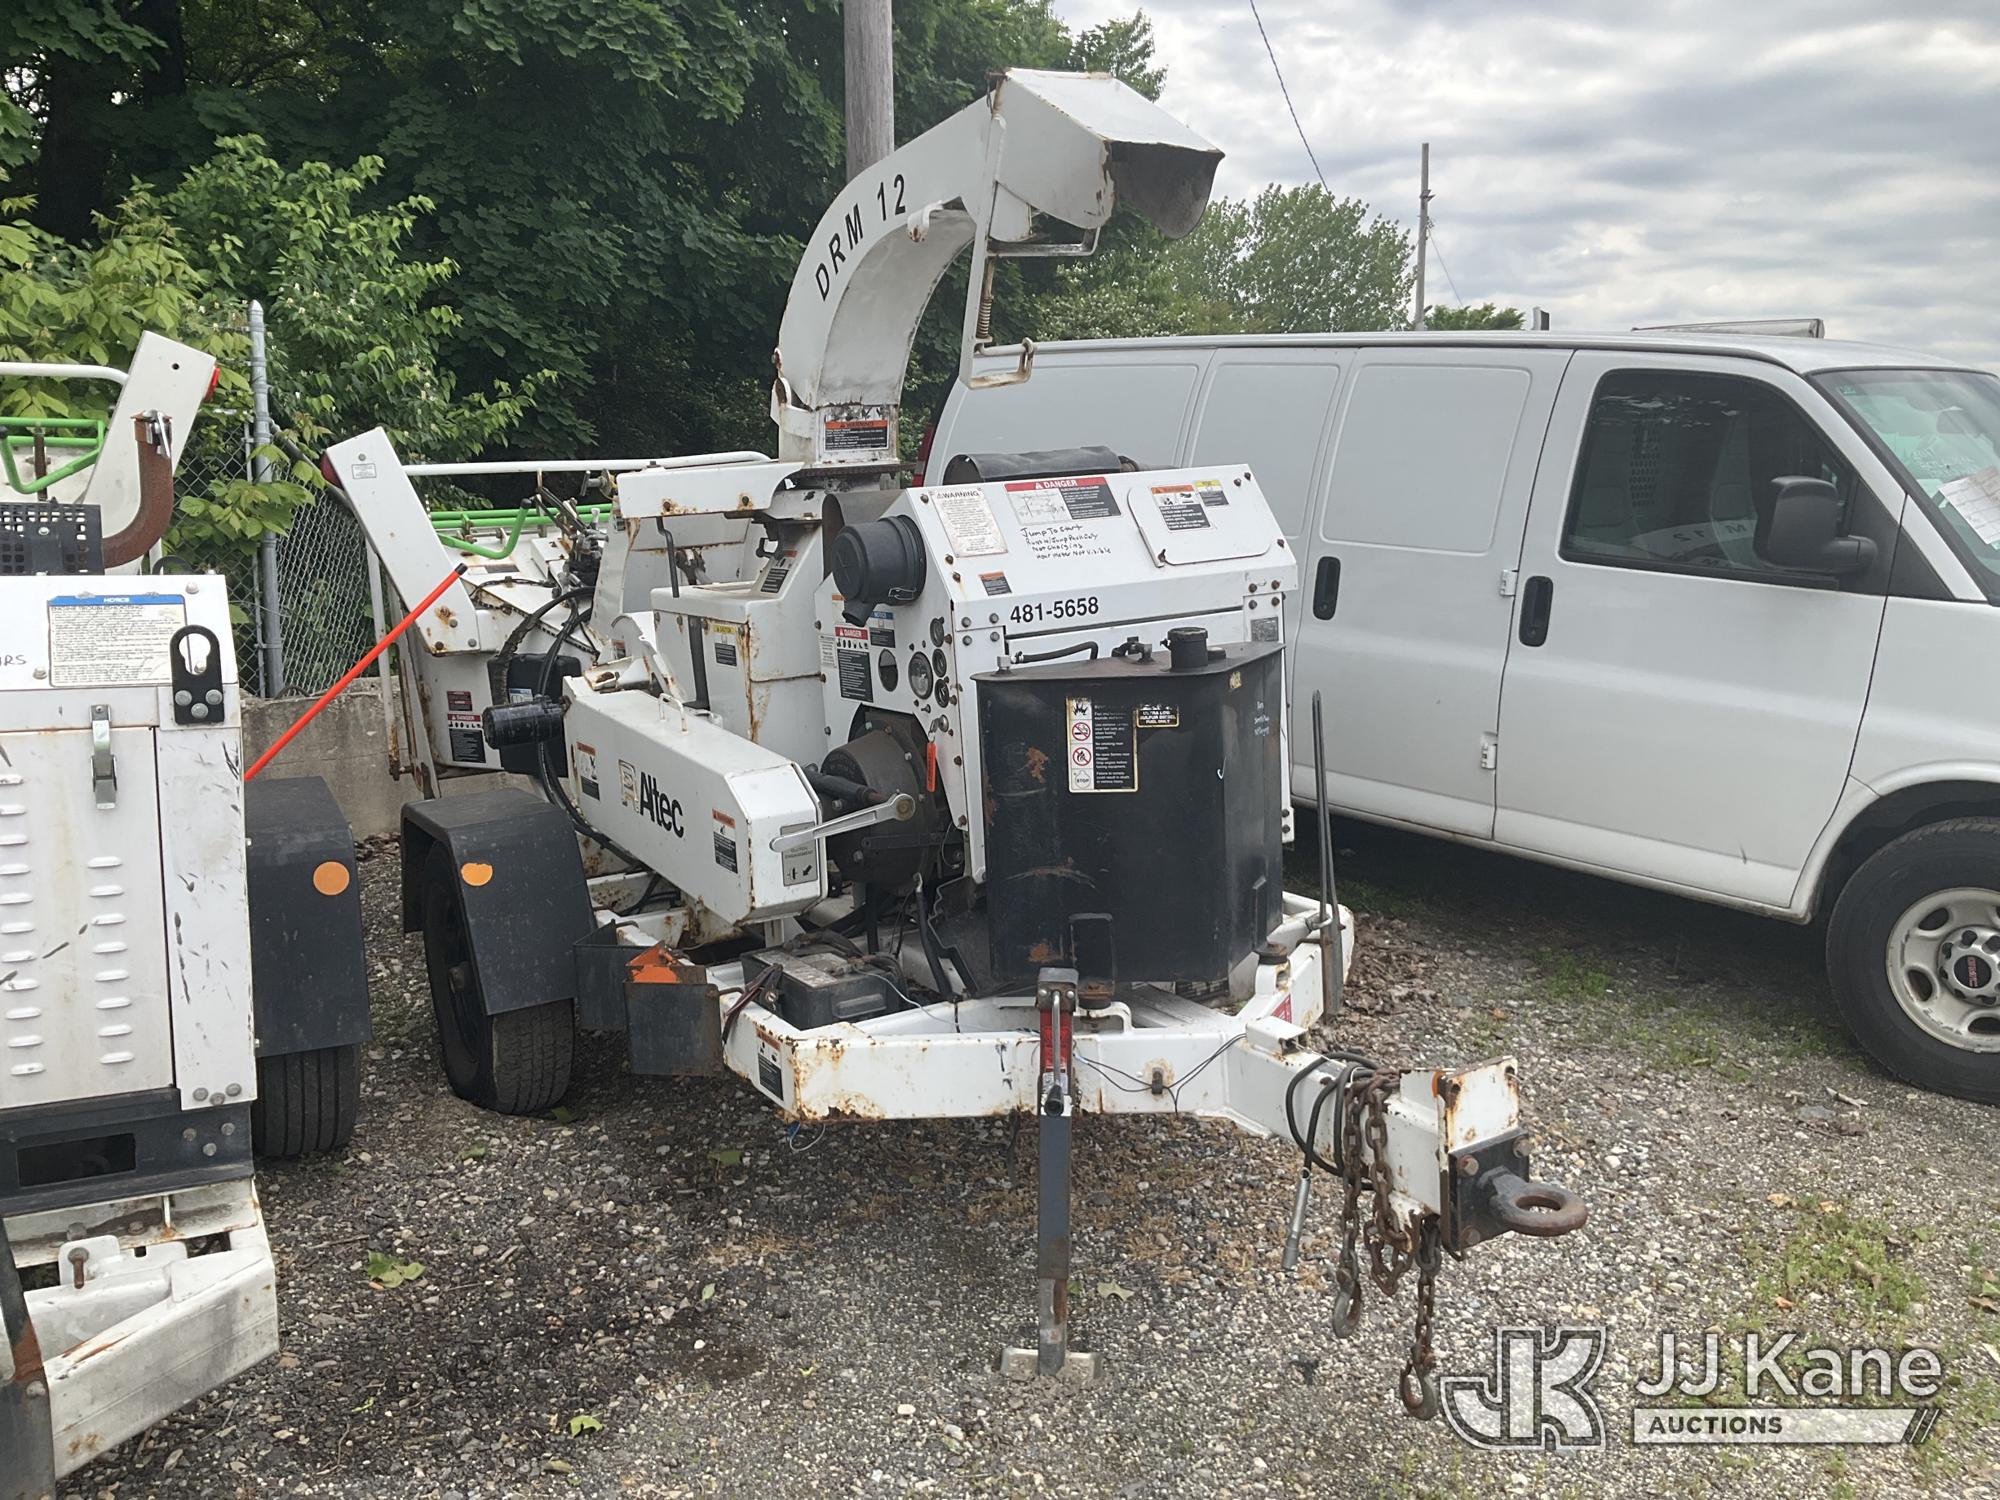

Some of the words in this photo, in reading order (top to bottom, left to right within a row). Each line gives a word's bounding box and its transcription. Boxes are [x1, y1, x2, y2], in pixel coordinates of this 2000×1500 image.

[815, 203, 864, 302] DRM
[877, 173, 906, 222] 12
[1043, 479, 1078, 489] DANGER
[942, 490, 980, 499] WARNING
[1020, 527, 1047, 538] Jump
[1010, 596, 1099, 624] 481-5658
[843, 629, 862, 638] DANGER
[0, 654, 26, 666] RS
[640, 772, 685, 838] Altec
